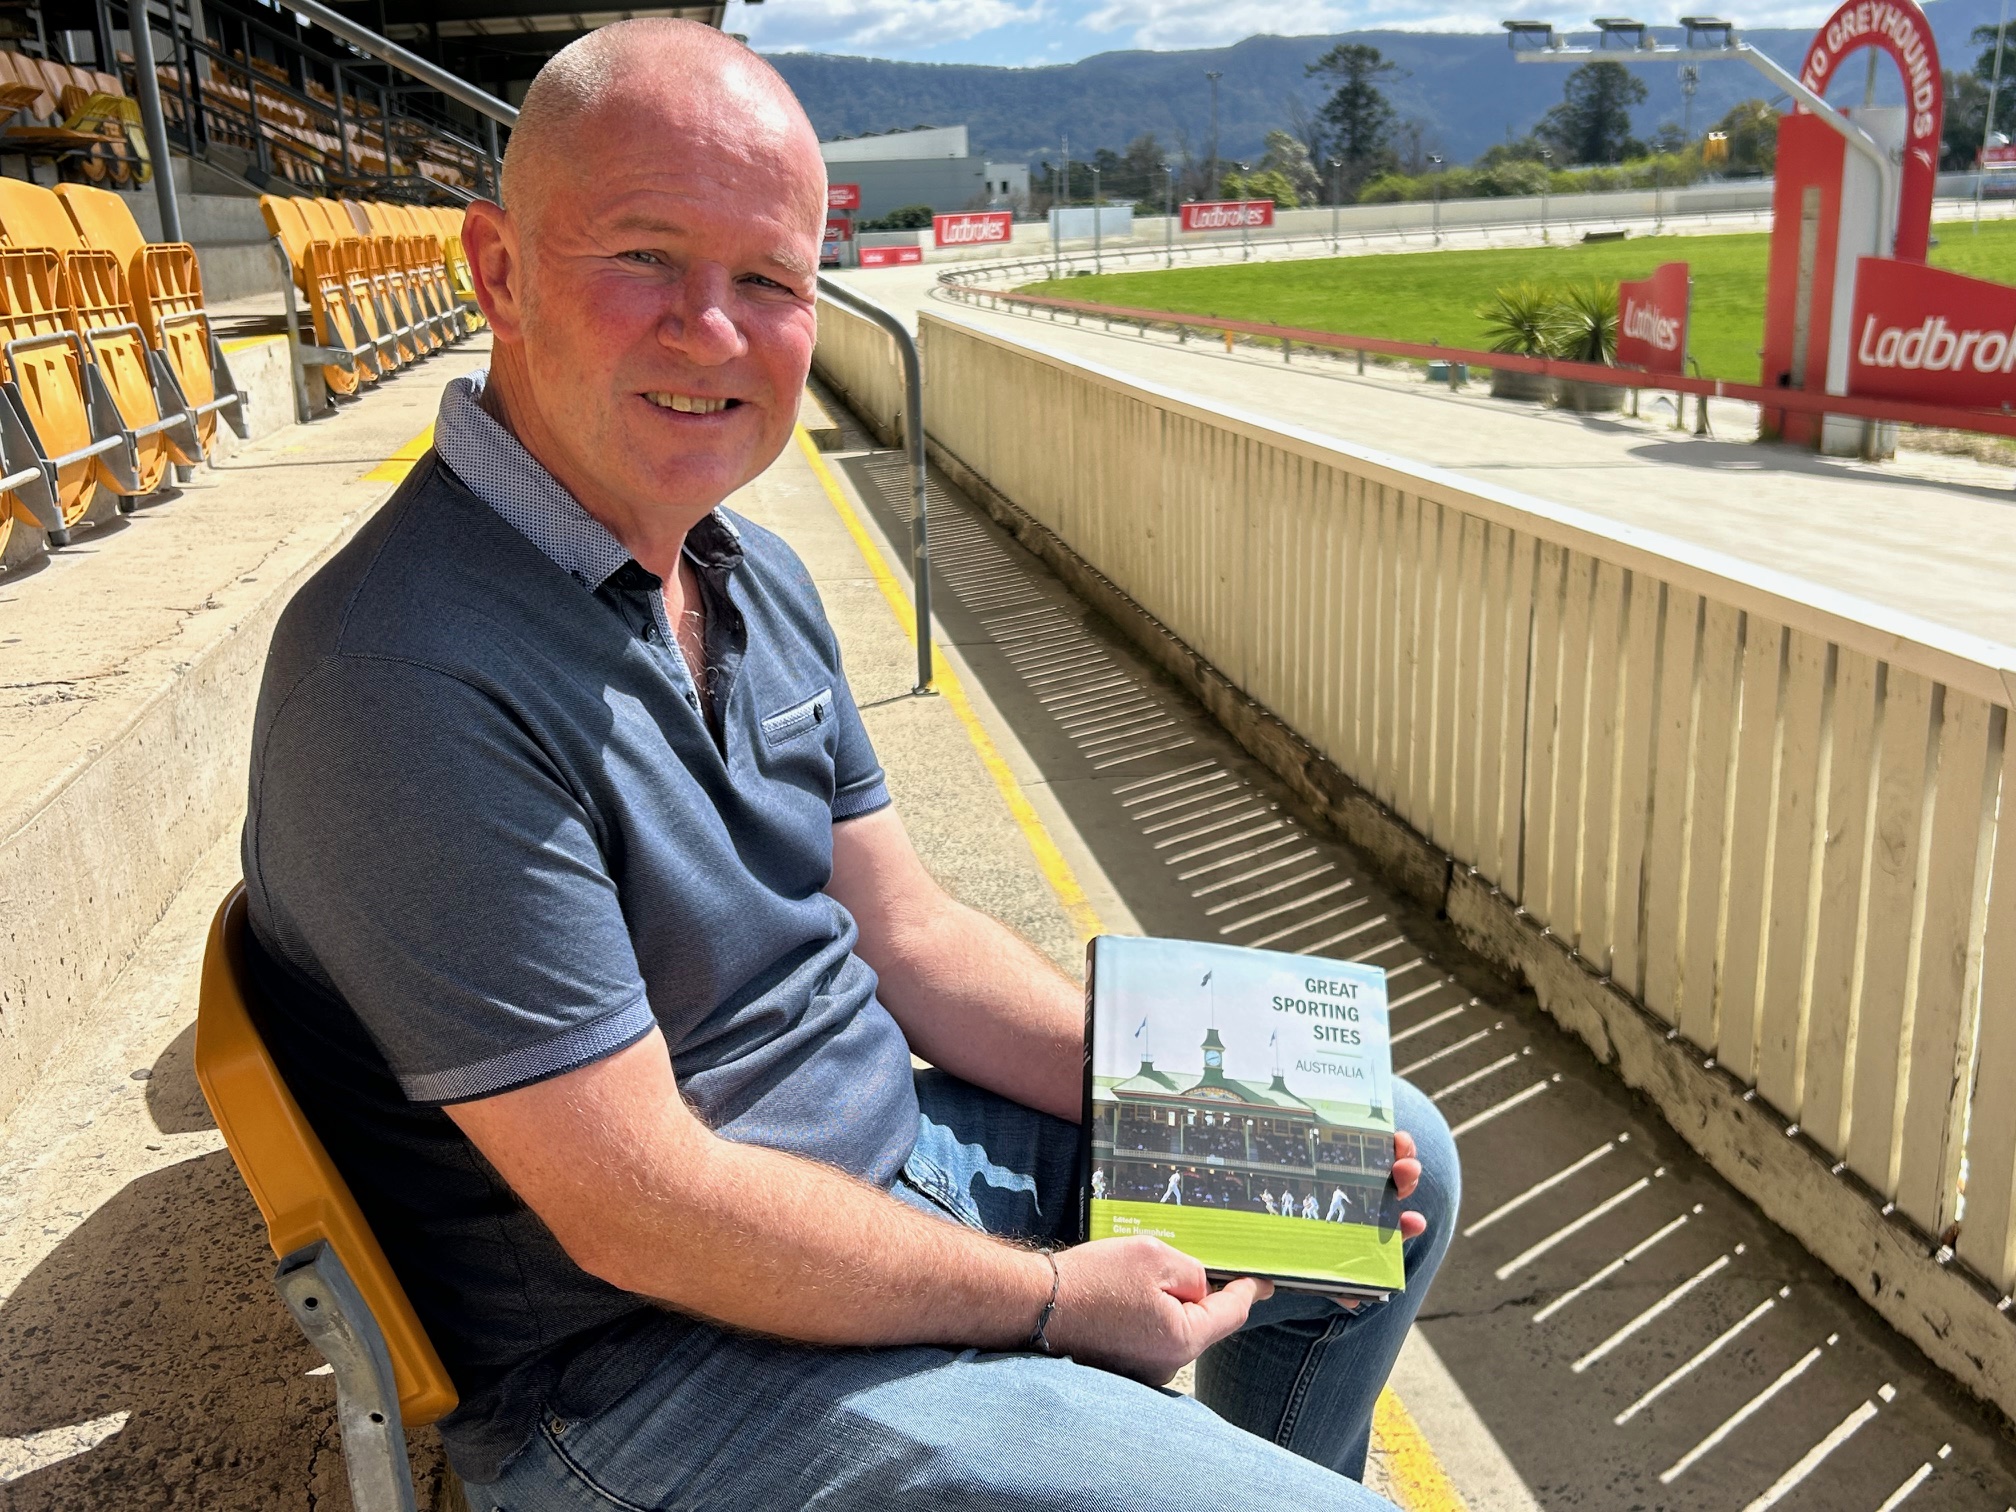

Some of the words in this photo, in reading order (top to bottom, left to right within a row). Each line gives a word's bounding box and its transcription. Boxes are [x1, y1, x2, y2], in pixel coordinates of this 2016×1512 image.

[1802, 47, 1829, 92] TO
[1826, 1, 1935, 139] GREYHOUNDS
[1190, 204, 1265, 229] Ladbrokes
[942, 216, 1006, 244] Ladbrokes
[1304, 977, 1359, 1000] GREAT
[1271, 995, 1360, 1022] SPORTING
[1313, 1024, 1361, 1046] SITES
[1295, 1059, 1365, 1080] AUSTRALIA
[1112, 1224, 1132, 1235] Glen
[1132, 1226, 1176, 1239] Humphries
[1113, 1215, 1133, 1225] Edited
[1133, 1217, 1142, 1227] by
